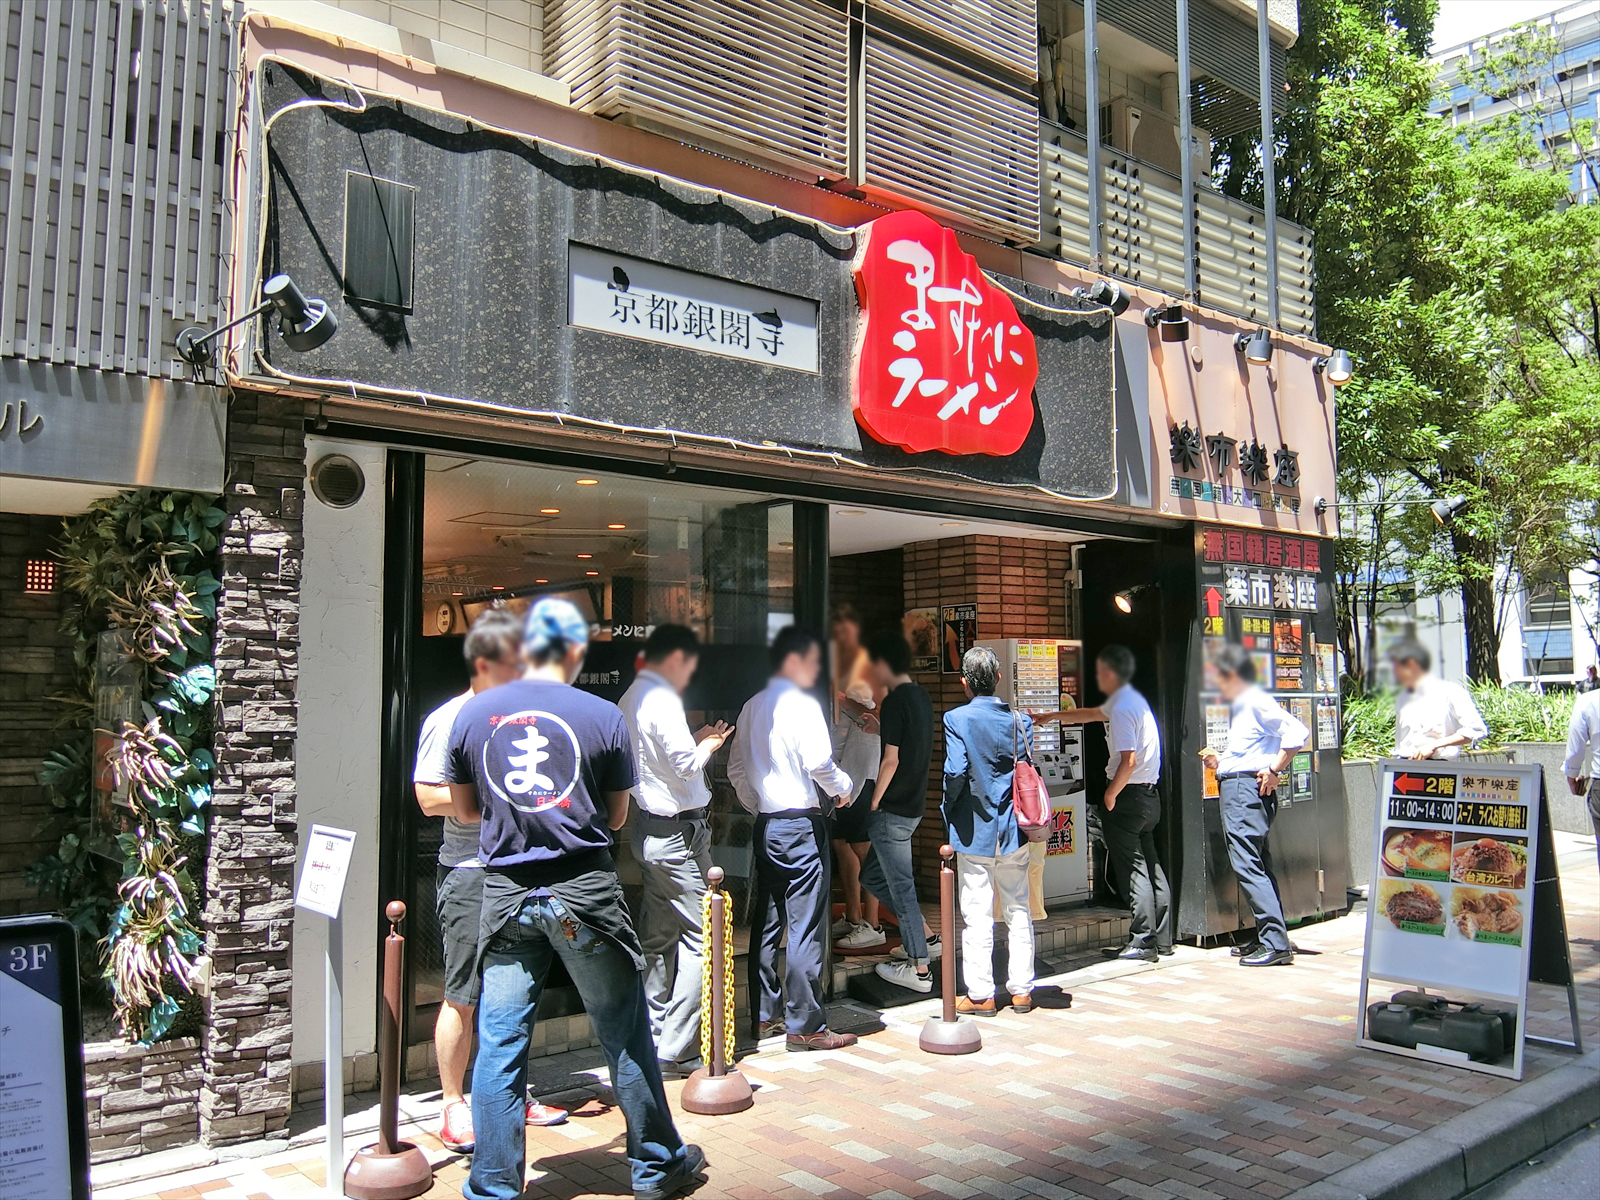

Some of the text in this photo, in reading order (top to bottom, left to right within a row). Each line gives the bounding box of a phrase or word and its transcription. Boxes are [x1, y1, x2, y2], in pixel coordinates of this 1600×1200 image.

[607, 266, 785, 357] 京都銀閣寺
[887, 330, 1019, 425] ラーメン
[1204, 529, 1320, 572] 無国籍居酒屋
[1225, 567, 1318, 609] 楽市楽座
[944, 608, 955, 621] 2F
[1203, 616, 1224, 635] 2階
[575, 670, 620, 685] 都銀閣寺
[504, 725, 555, 794] ま
[1425, 777, 1456, 795] 2階
[1047, 828, 1072, 850] 無料
[1466, 871, 1513, 886] 台湾カレー
[9, 942, 52, 972] 3F
